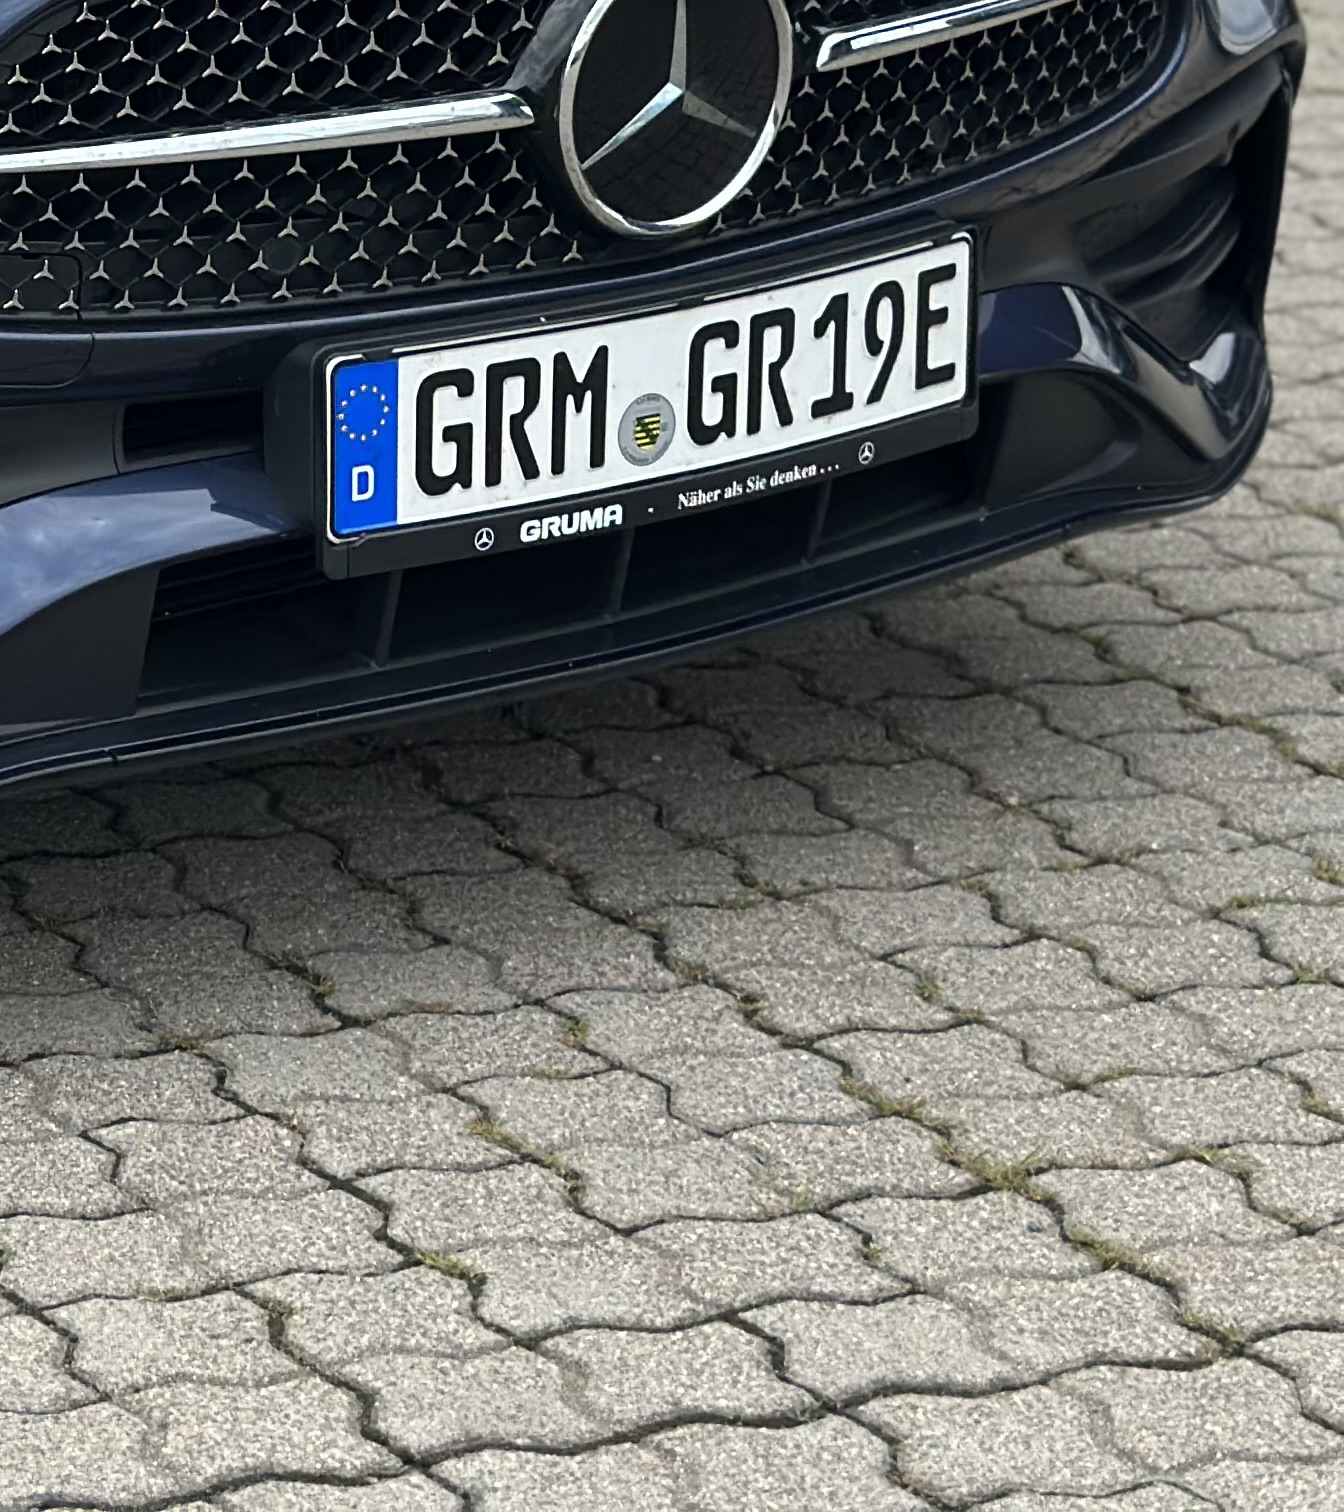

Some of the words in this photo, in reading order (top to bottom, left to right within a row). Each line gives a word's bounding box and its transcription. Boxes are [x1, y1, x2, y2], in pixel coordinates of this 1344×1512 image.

[416, 345, 608, 496] GRM
[687, 263, 957, 447] GR19E
[352, 464, 375, 502] D
[678, 488, 721, 510] Näher
[724, 483, 743, 499] als
[746, 475, 767, 494] Sie
[520, 503, 623, 543] GRUMA
